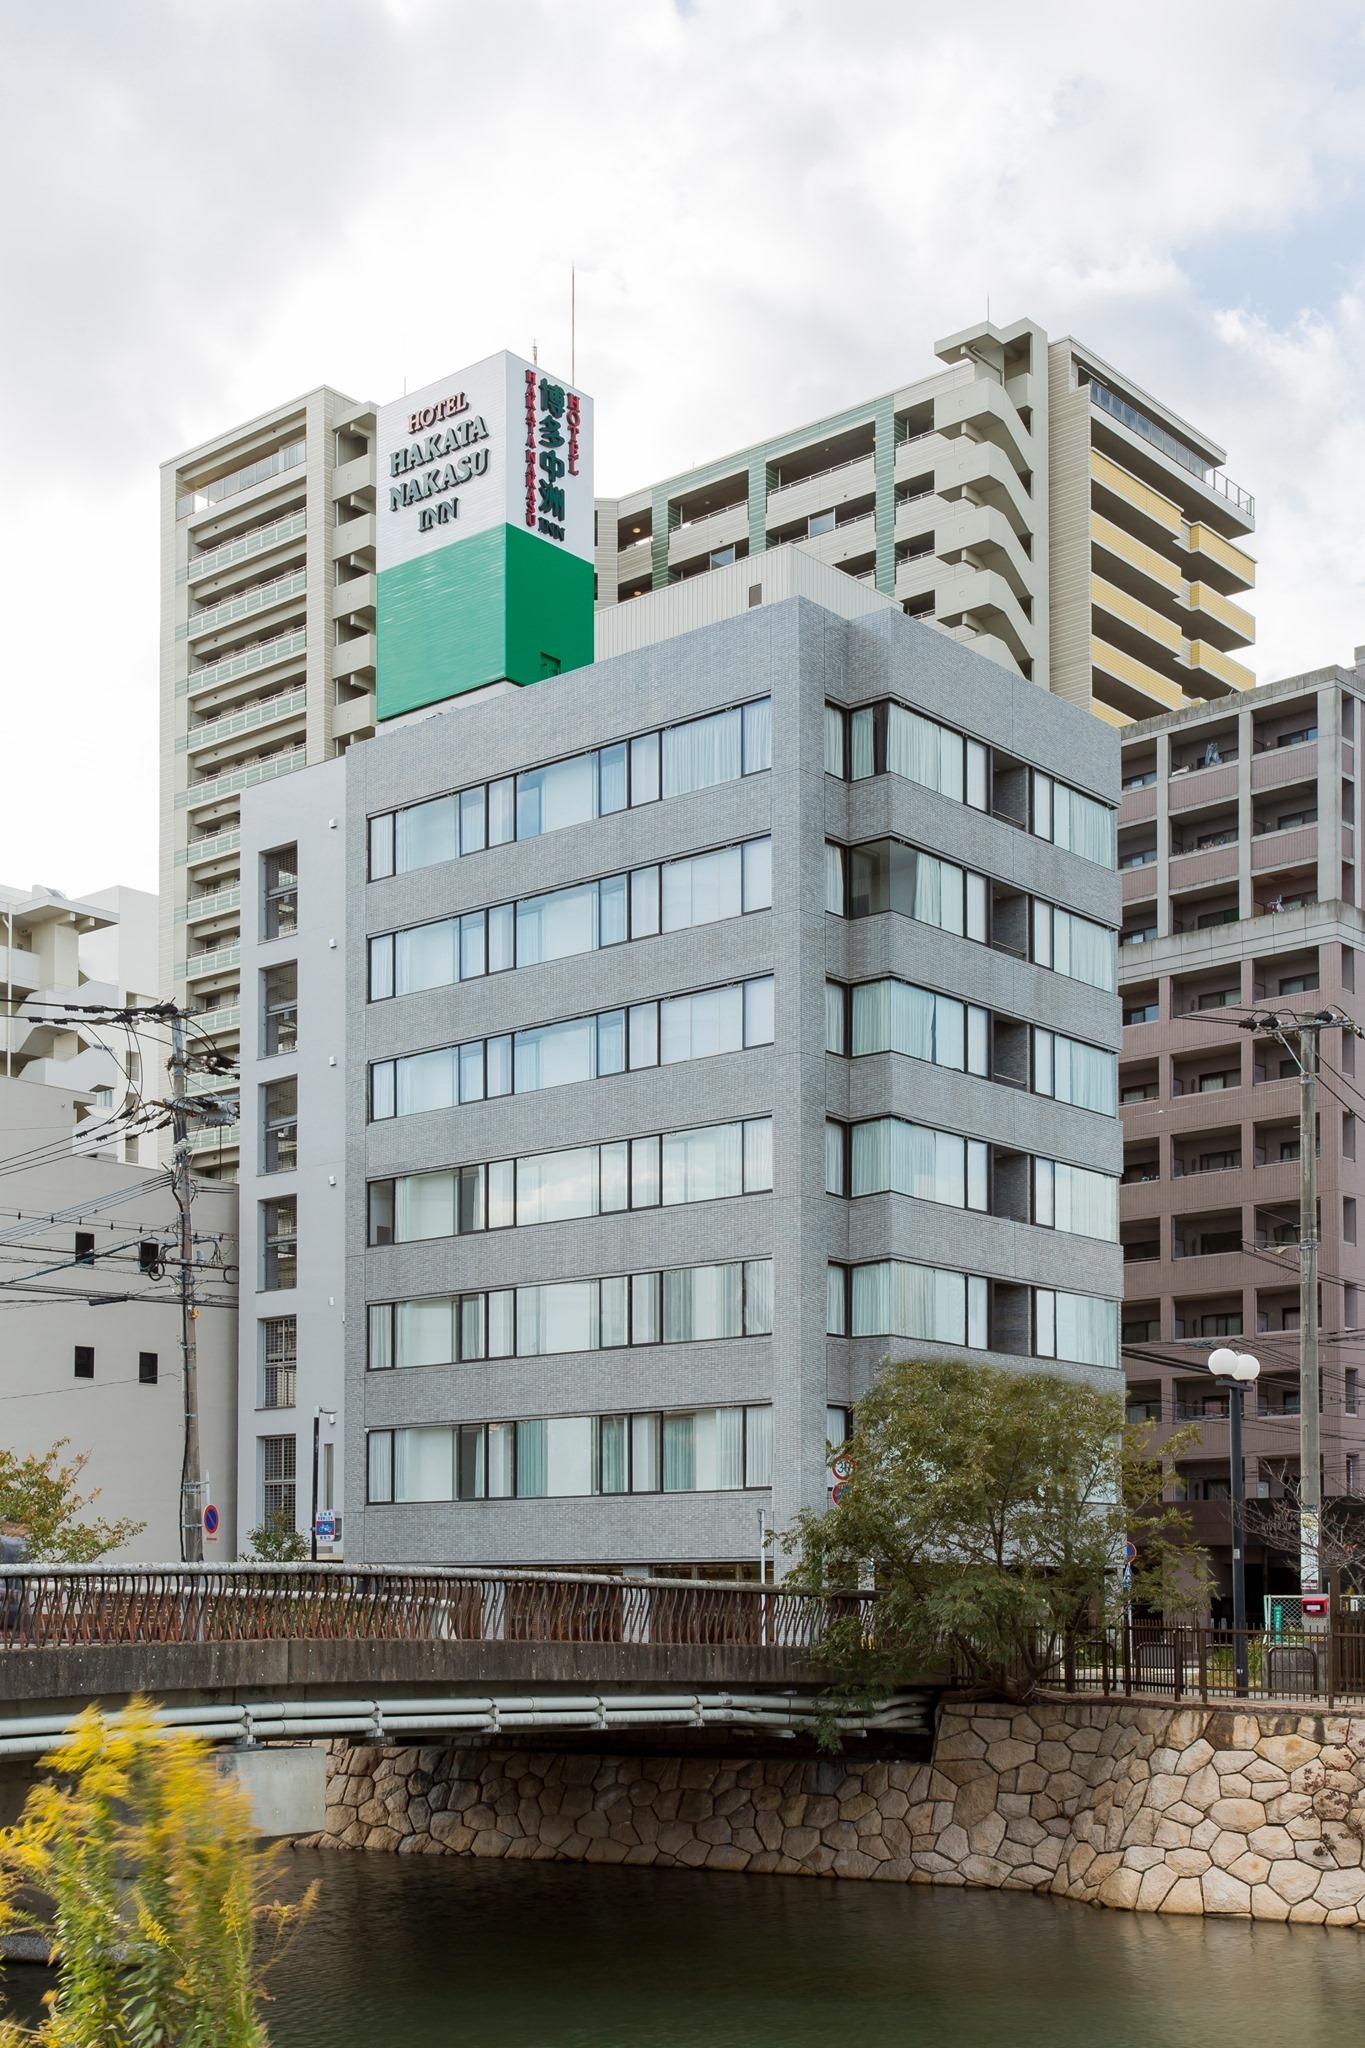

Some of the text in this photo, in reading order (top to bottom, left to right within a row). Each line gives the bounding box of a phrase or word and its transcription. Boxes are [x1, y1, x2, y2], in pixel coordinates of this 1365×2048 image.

[407, 391, 469, 434] HOTEL
[566, 392, 580, 476] HOTEL
[389, 415, 489, 478] HAKATA
[525, 369, 536, 527] HAKATA NAKASU
[389, 447, 489, 512] NAKASU
[418, 497, 459, 533] INN
[538, 516, 566, 542] INN
